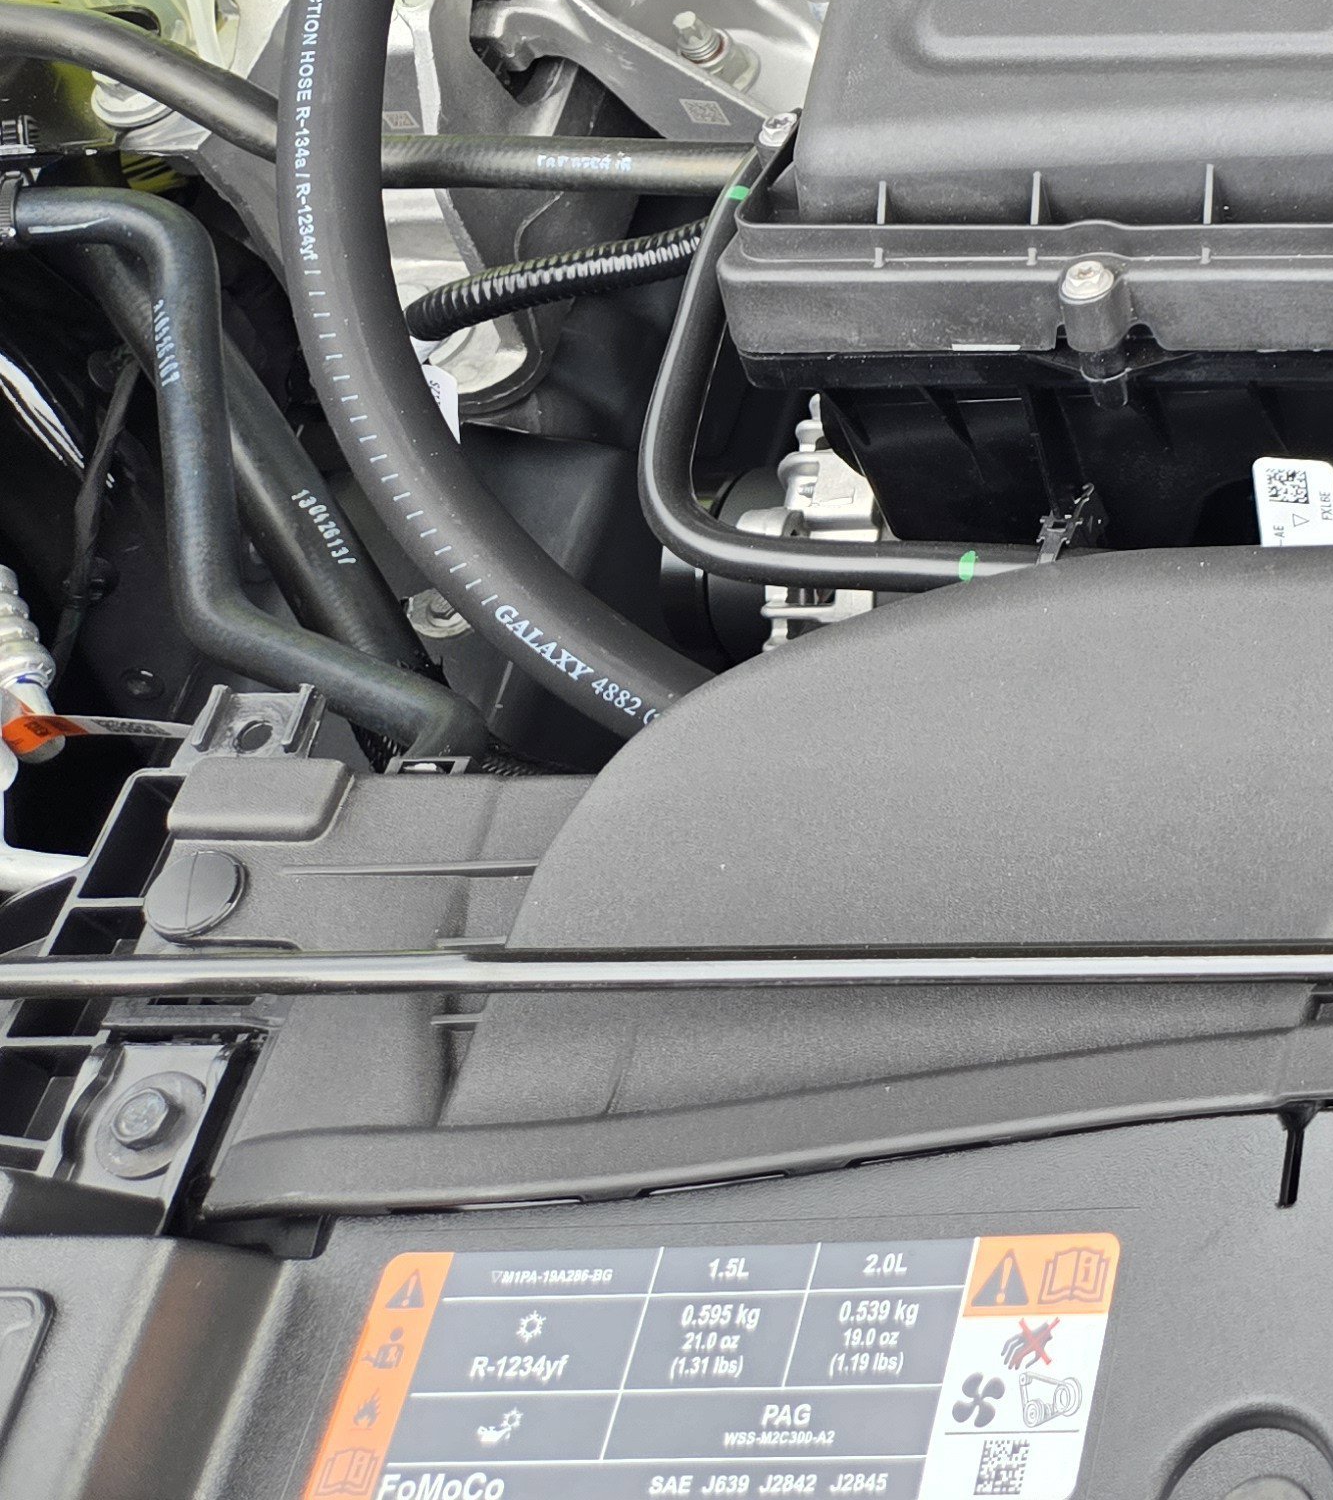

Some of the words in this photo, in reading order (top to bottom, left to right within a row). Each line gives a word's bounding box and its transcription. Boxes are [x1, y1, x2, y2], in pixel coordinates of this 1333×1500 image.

[296, 50, 316, 102] HOSE
[294, 106, 312, 170] R-134a
[296, 182, 318, 261] R-1234yf
[494, 604, 595, 681] GALAXY
[591, 677, 642, 716] 4882
[709, 1257, 750, 1278] 1.5L
[863, 1252, 908, 1274] 2.0L
[681, 1304, 733, 1327] 0.595
[735, 1303, 761, 1331] kg
[838, 1300, 891, 1323] 0.539
[894, 1298, 920, 1326] kg
[681, 1331, 717, 1351] 21.0
[719, 1333, 740, 1350] oz
[843, 1328, 877, 1348] 19.0
[878, 1330, 900, 1347] oz
[469, 1353, 570, 1383] R-1234yf
[669, 1356, 709, 1381] (1.31
[712, 1354, 745, 1379] lbs)
[828, 1352, 870, 1378] (1.19
[872, 1351, 905, 1376] lbs)
[761, 1403, 812, 1427] PAG
[723, 1429, 836, 1447] WSS-M2C300-A2
[377, 1472, 505, 1500] FoMoCo
[648, 1474, 694, 1496] SAE
[702, 1474, 750, 1494] J639
[758, 1473, 818, 1493] J2842
[829, 1471, 888, 1493] J2845
